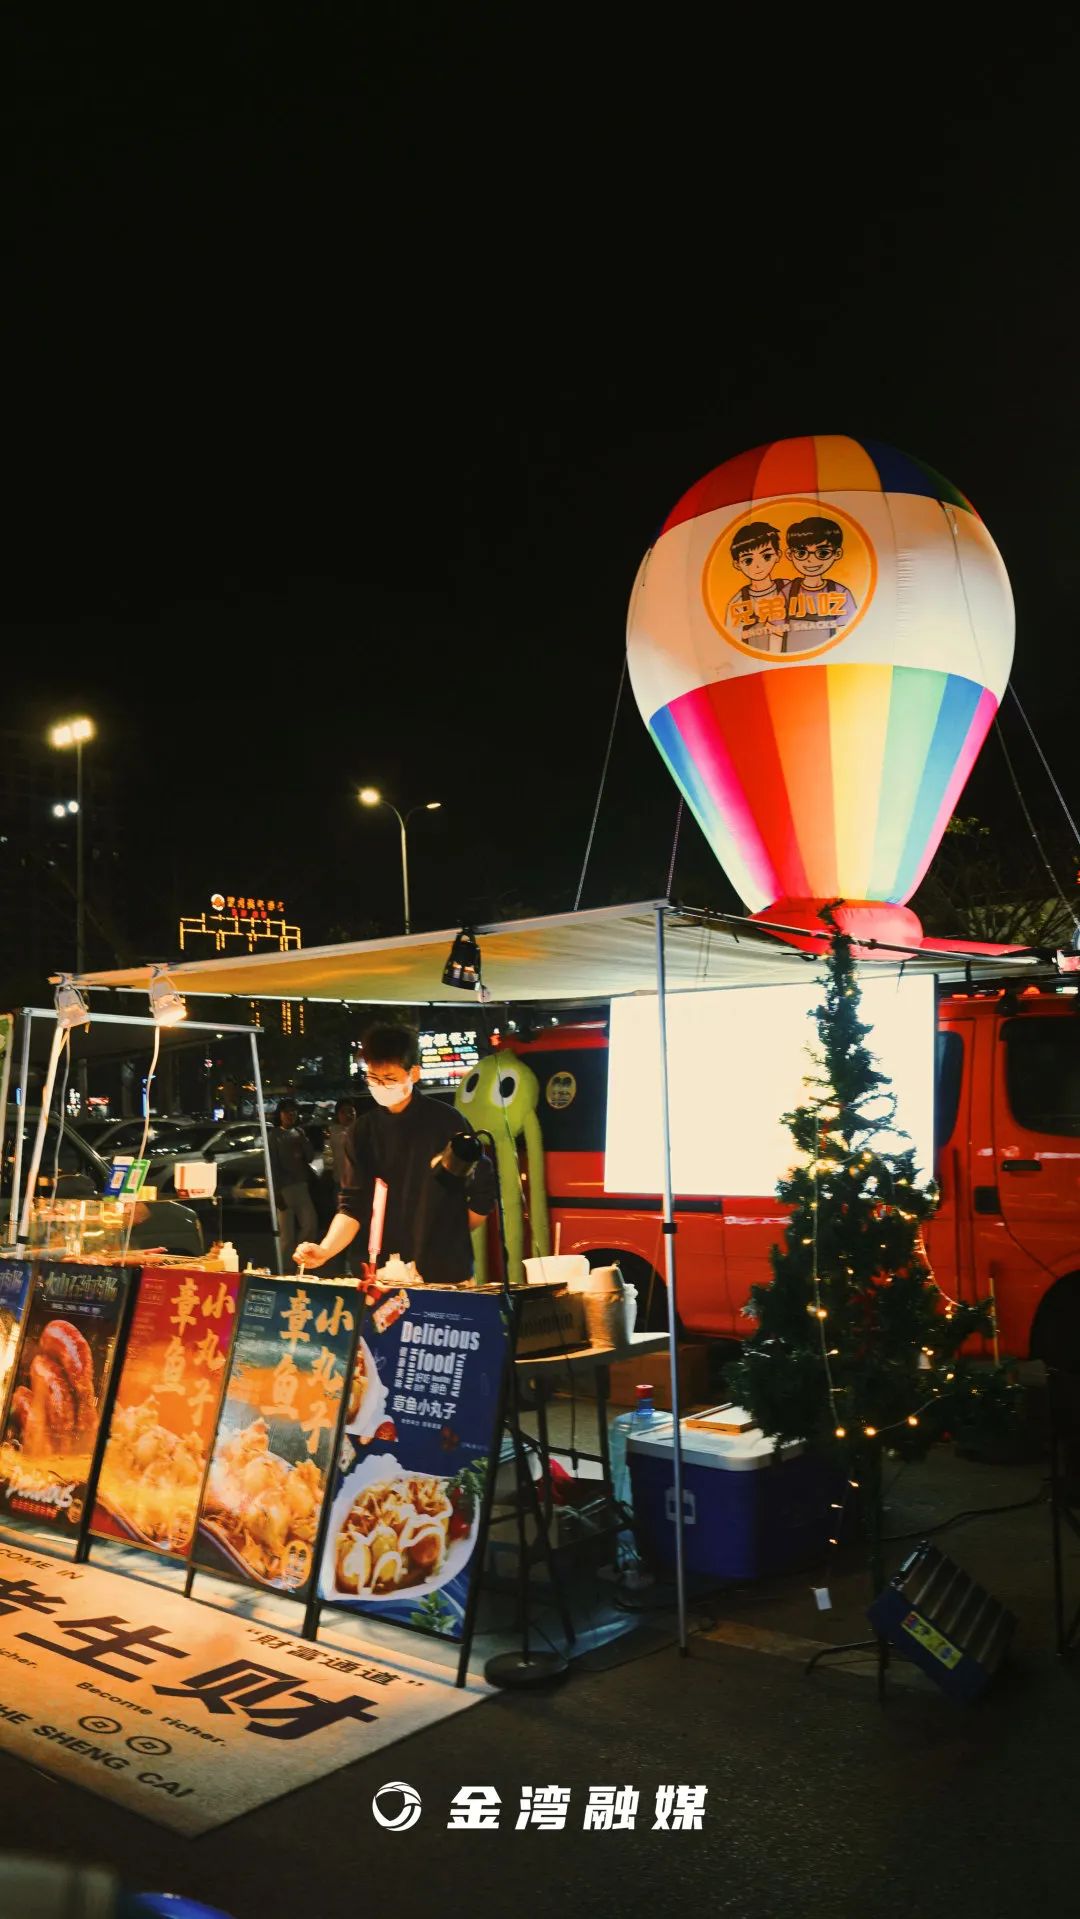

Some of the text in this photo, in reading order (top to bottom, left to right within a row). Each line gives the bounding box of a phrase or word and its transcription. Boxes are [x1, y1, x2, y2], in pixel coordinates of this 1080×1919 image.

[730, 592, 848, 628] 兄弟小吃
[400, 1321, 481, 1351] Delicious
[416, 1349, 456, 1375] food
[392, 1394, 457, 1420] 章鱼小丸子
[56, 1569, 84, 1580] IN
[76, 1682, 226, 1747] Become richer.
[0, 1703, 196, 1798] HE SHENG CAI
